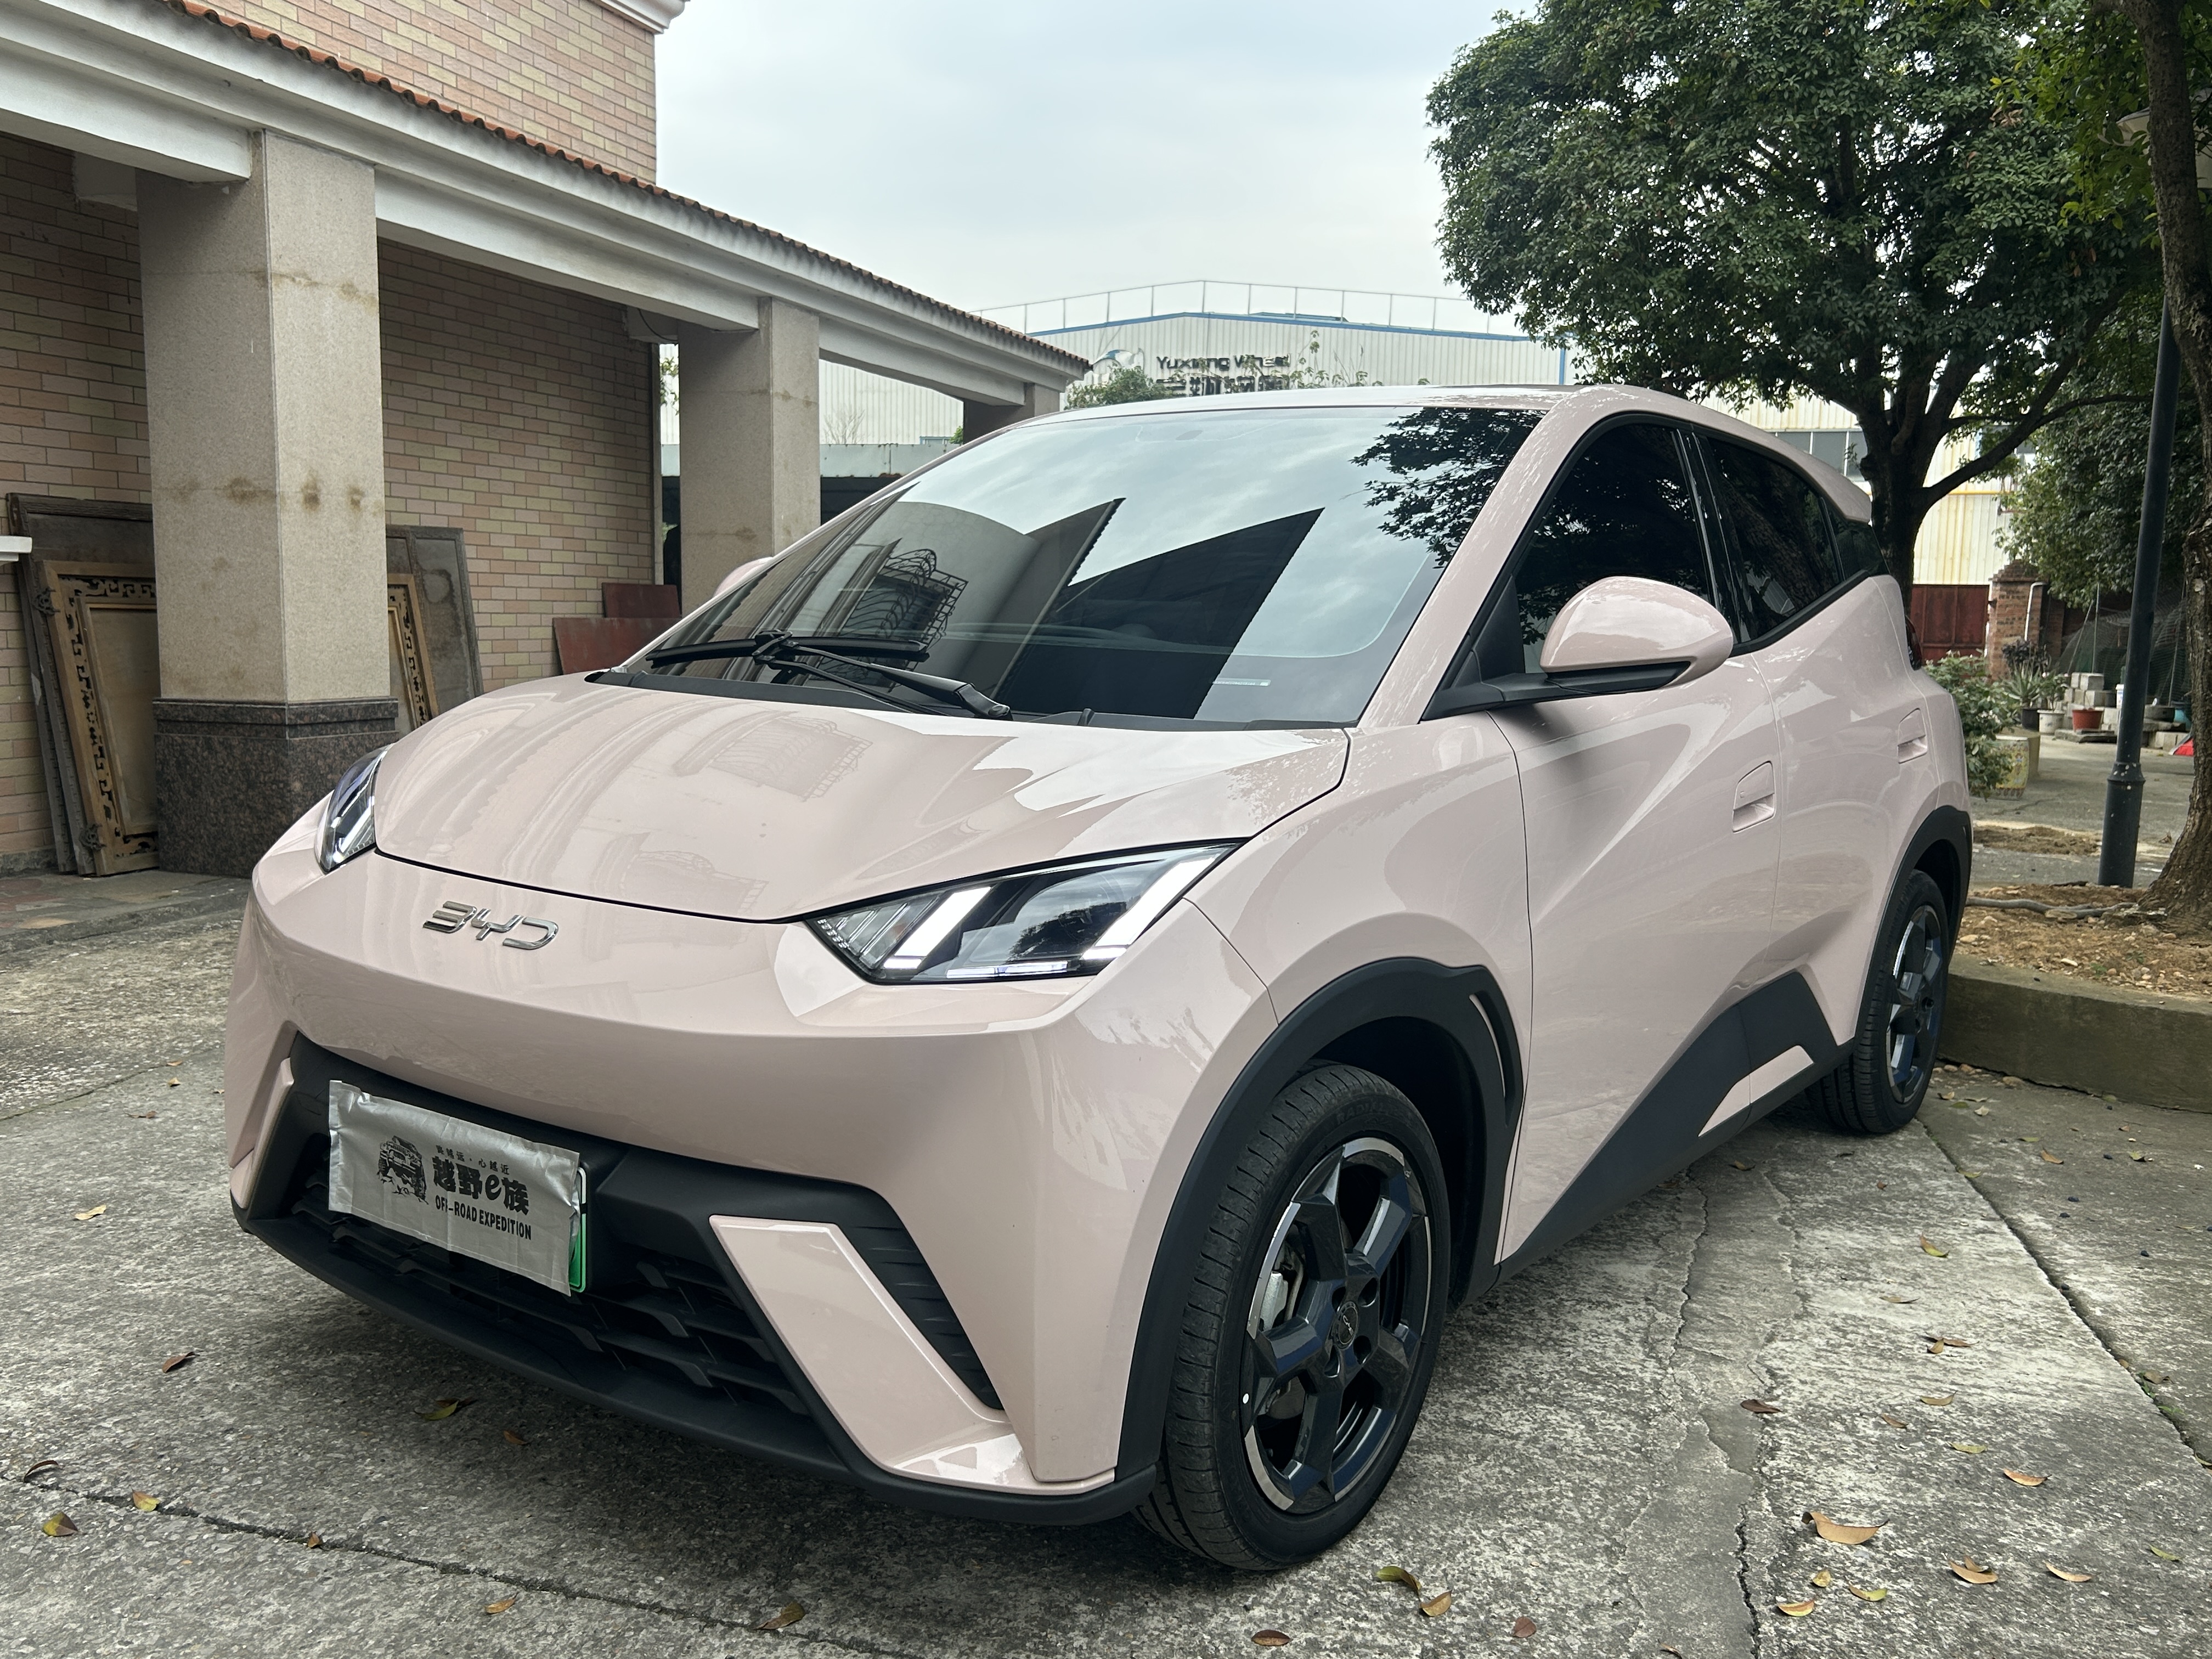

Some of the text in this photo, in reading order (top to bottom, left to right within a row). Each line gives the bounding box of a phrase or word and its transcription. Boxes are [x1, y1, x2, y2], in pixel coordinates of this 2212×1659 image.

[1156, 357, 1230, 371] Yuxing
[422, 901, 558, 950] BYD
[432, 1155, 529, 1215] 越野e族
[479, 1209, 532, 1240] EXPEDITION
